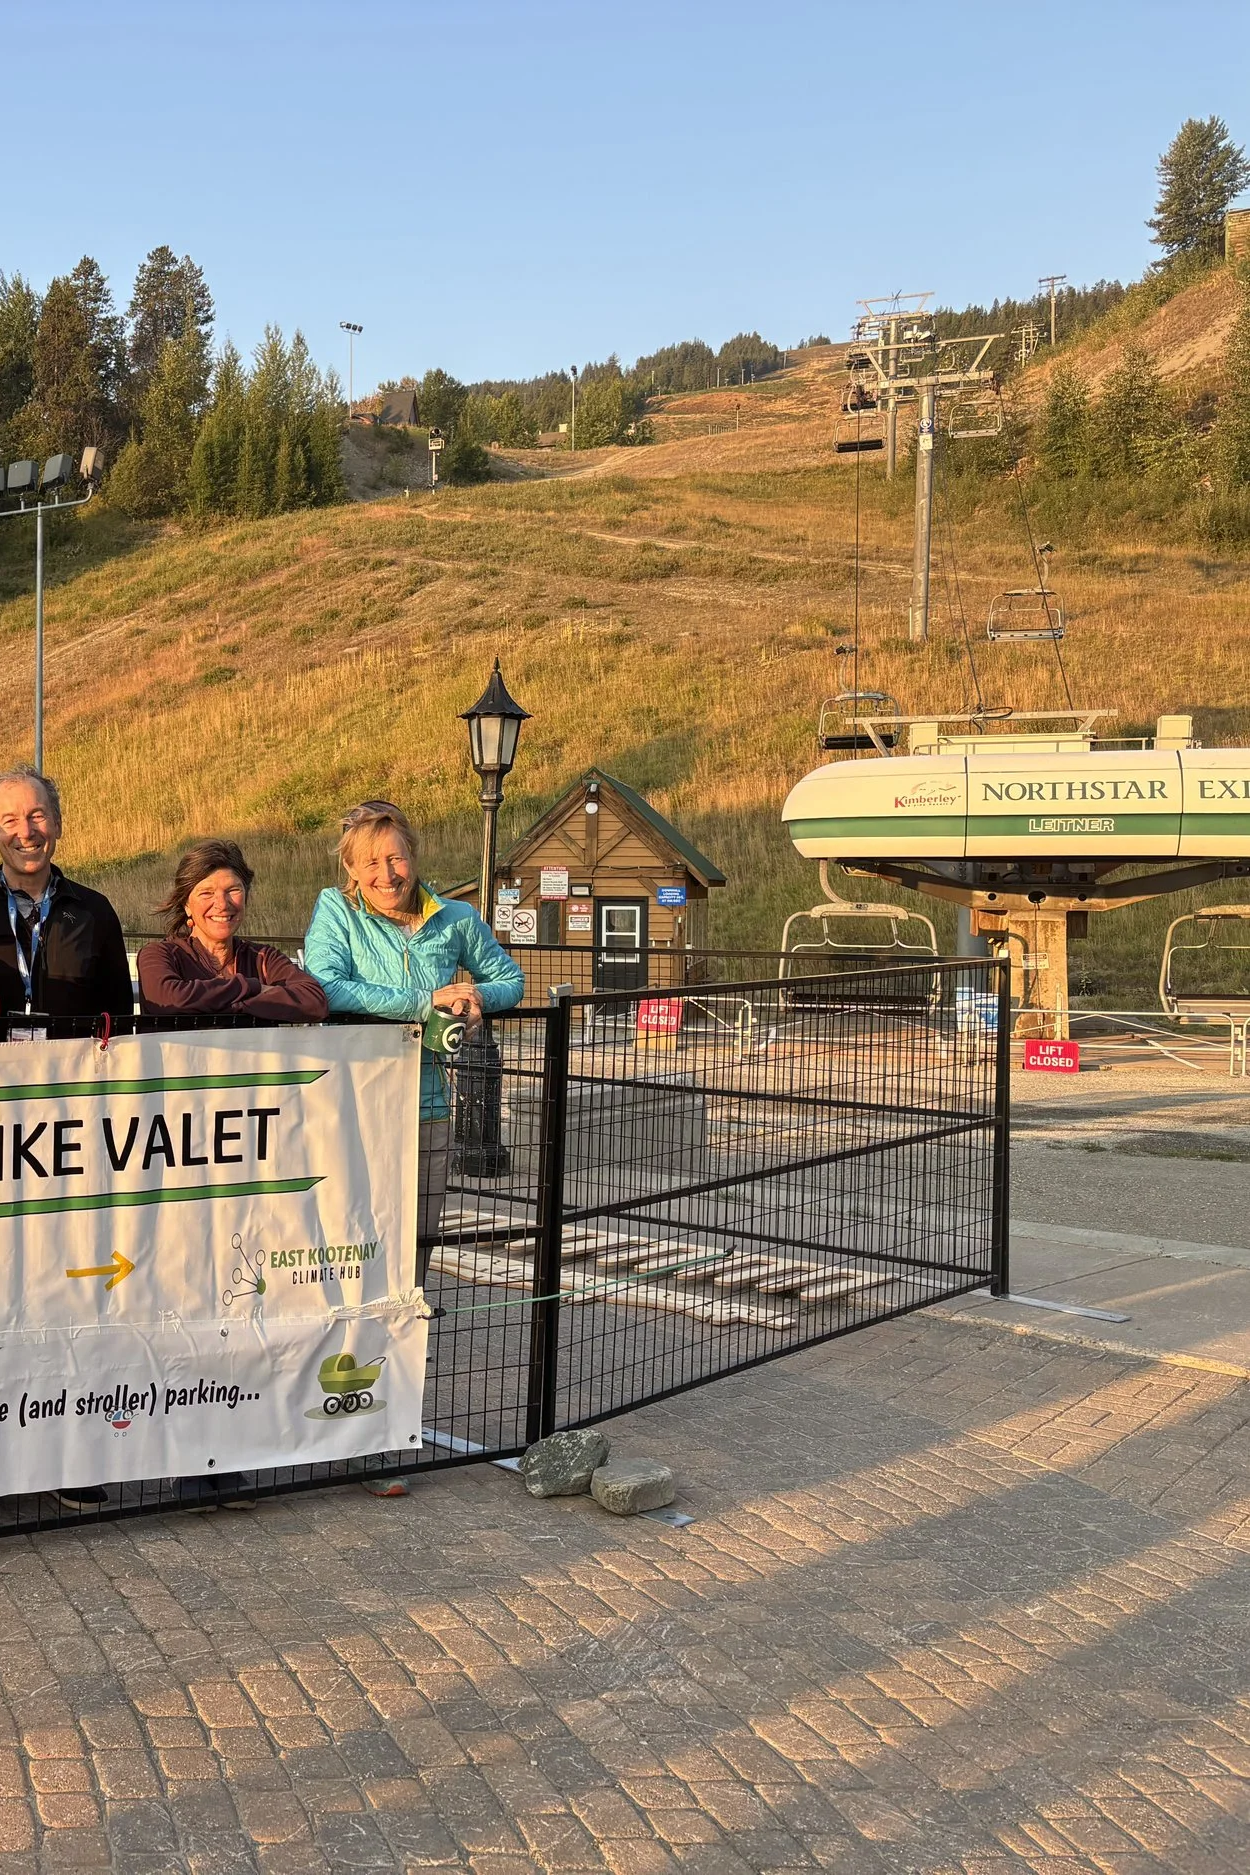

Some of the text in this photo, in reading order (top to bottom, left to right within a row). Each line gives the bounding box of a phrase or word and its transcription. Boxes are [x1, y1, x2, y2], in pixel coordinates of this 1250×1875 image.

[981, 780, 1169, 801] NORTHSTAR
[894, 794, 957, 809] Kimberley
[1028, 817, 1114, 832] LEITNER
[1039, 1045, 1064, 1056] LIFT
[1029, 1055, 1074, 1068] CLOSED
[102, 1108, 281, 1172] VALET
[270, 1241, 378, 1269] EAST KOOTENAY
[292, 1265, 361, 1285] CLIMATE HUB
[19, 1389, 67, 1428] (and
[75, 1382, 158, 1418] stroller)
[164, 1378, 261, 1415] parking...
